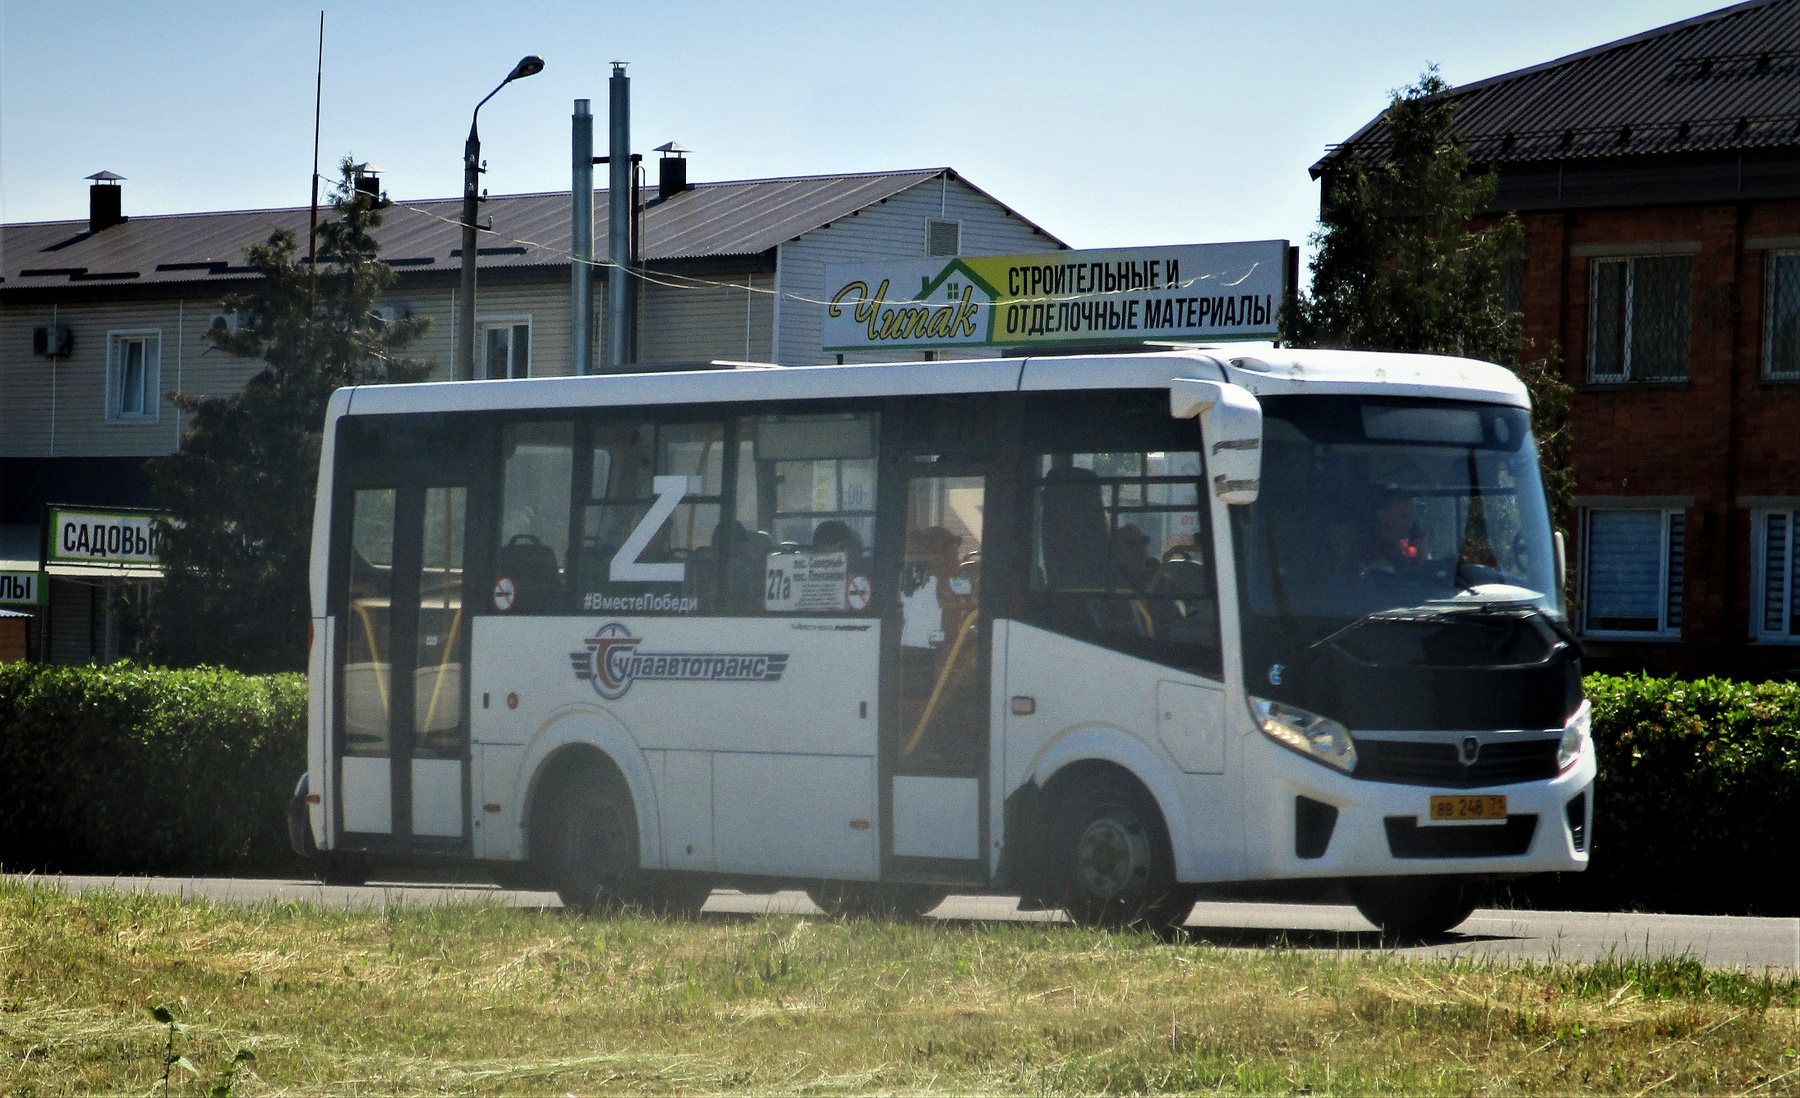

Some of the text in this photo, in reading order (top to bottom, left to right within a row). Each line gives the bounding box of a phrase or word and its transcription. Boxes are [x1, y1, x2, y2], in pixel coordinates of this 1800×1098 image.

[1008, 258, 1180, 297] СТРОИТЕЛЬНЫЕ И
[1007, 293, 1272, 336] ОТДЕЛОЧНЫЕ МАТЕРИАЛЫ
